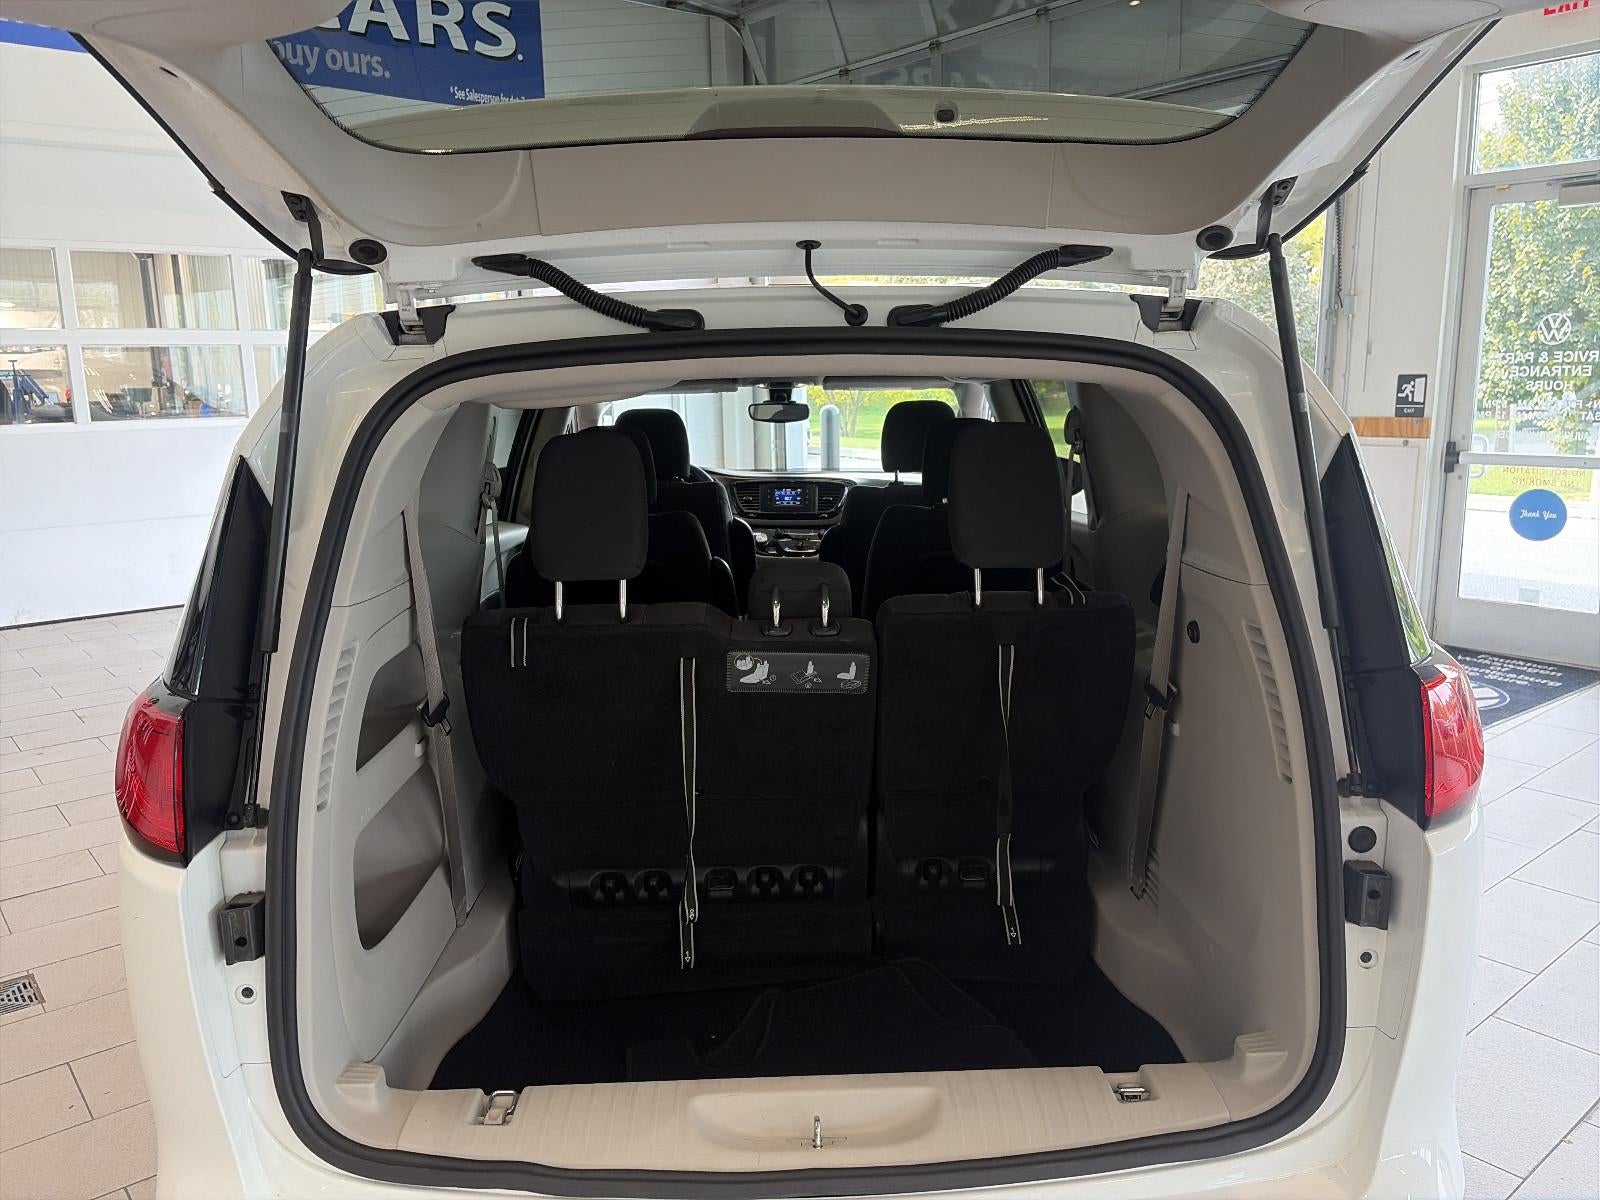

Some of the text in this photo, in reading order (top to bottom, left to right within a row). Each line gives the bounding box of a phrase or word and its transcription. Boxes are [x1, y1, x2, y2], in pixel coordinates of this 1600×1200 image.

[316, 0, 524, 62] ARS.
[325, 47, 392, 79] ours.
[1520, 509, 1558, 521] Thank You
